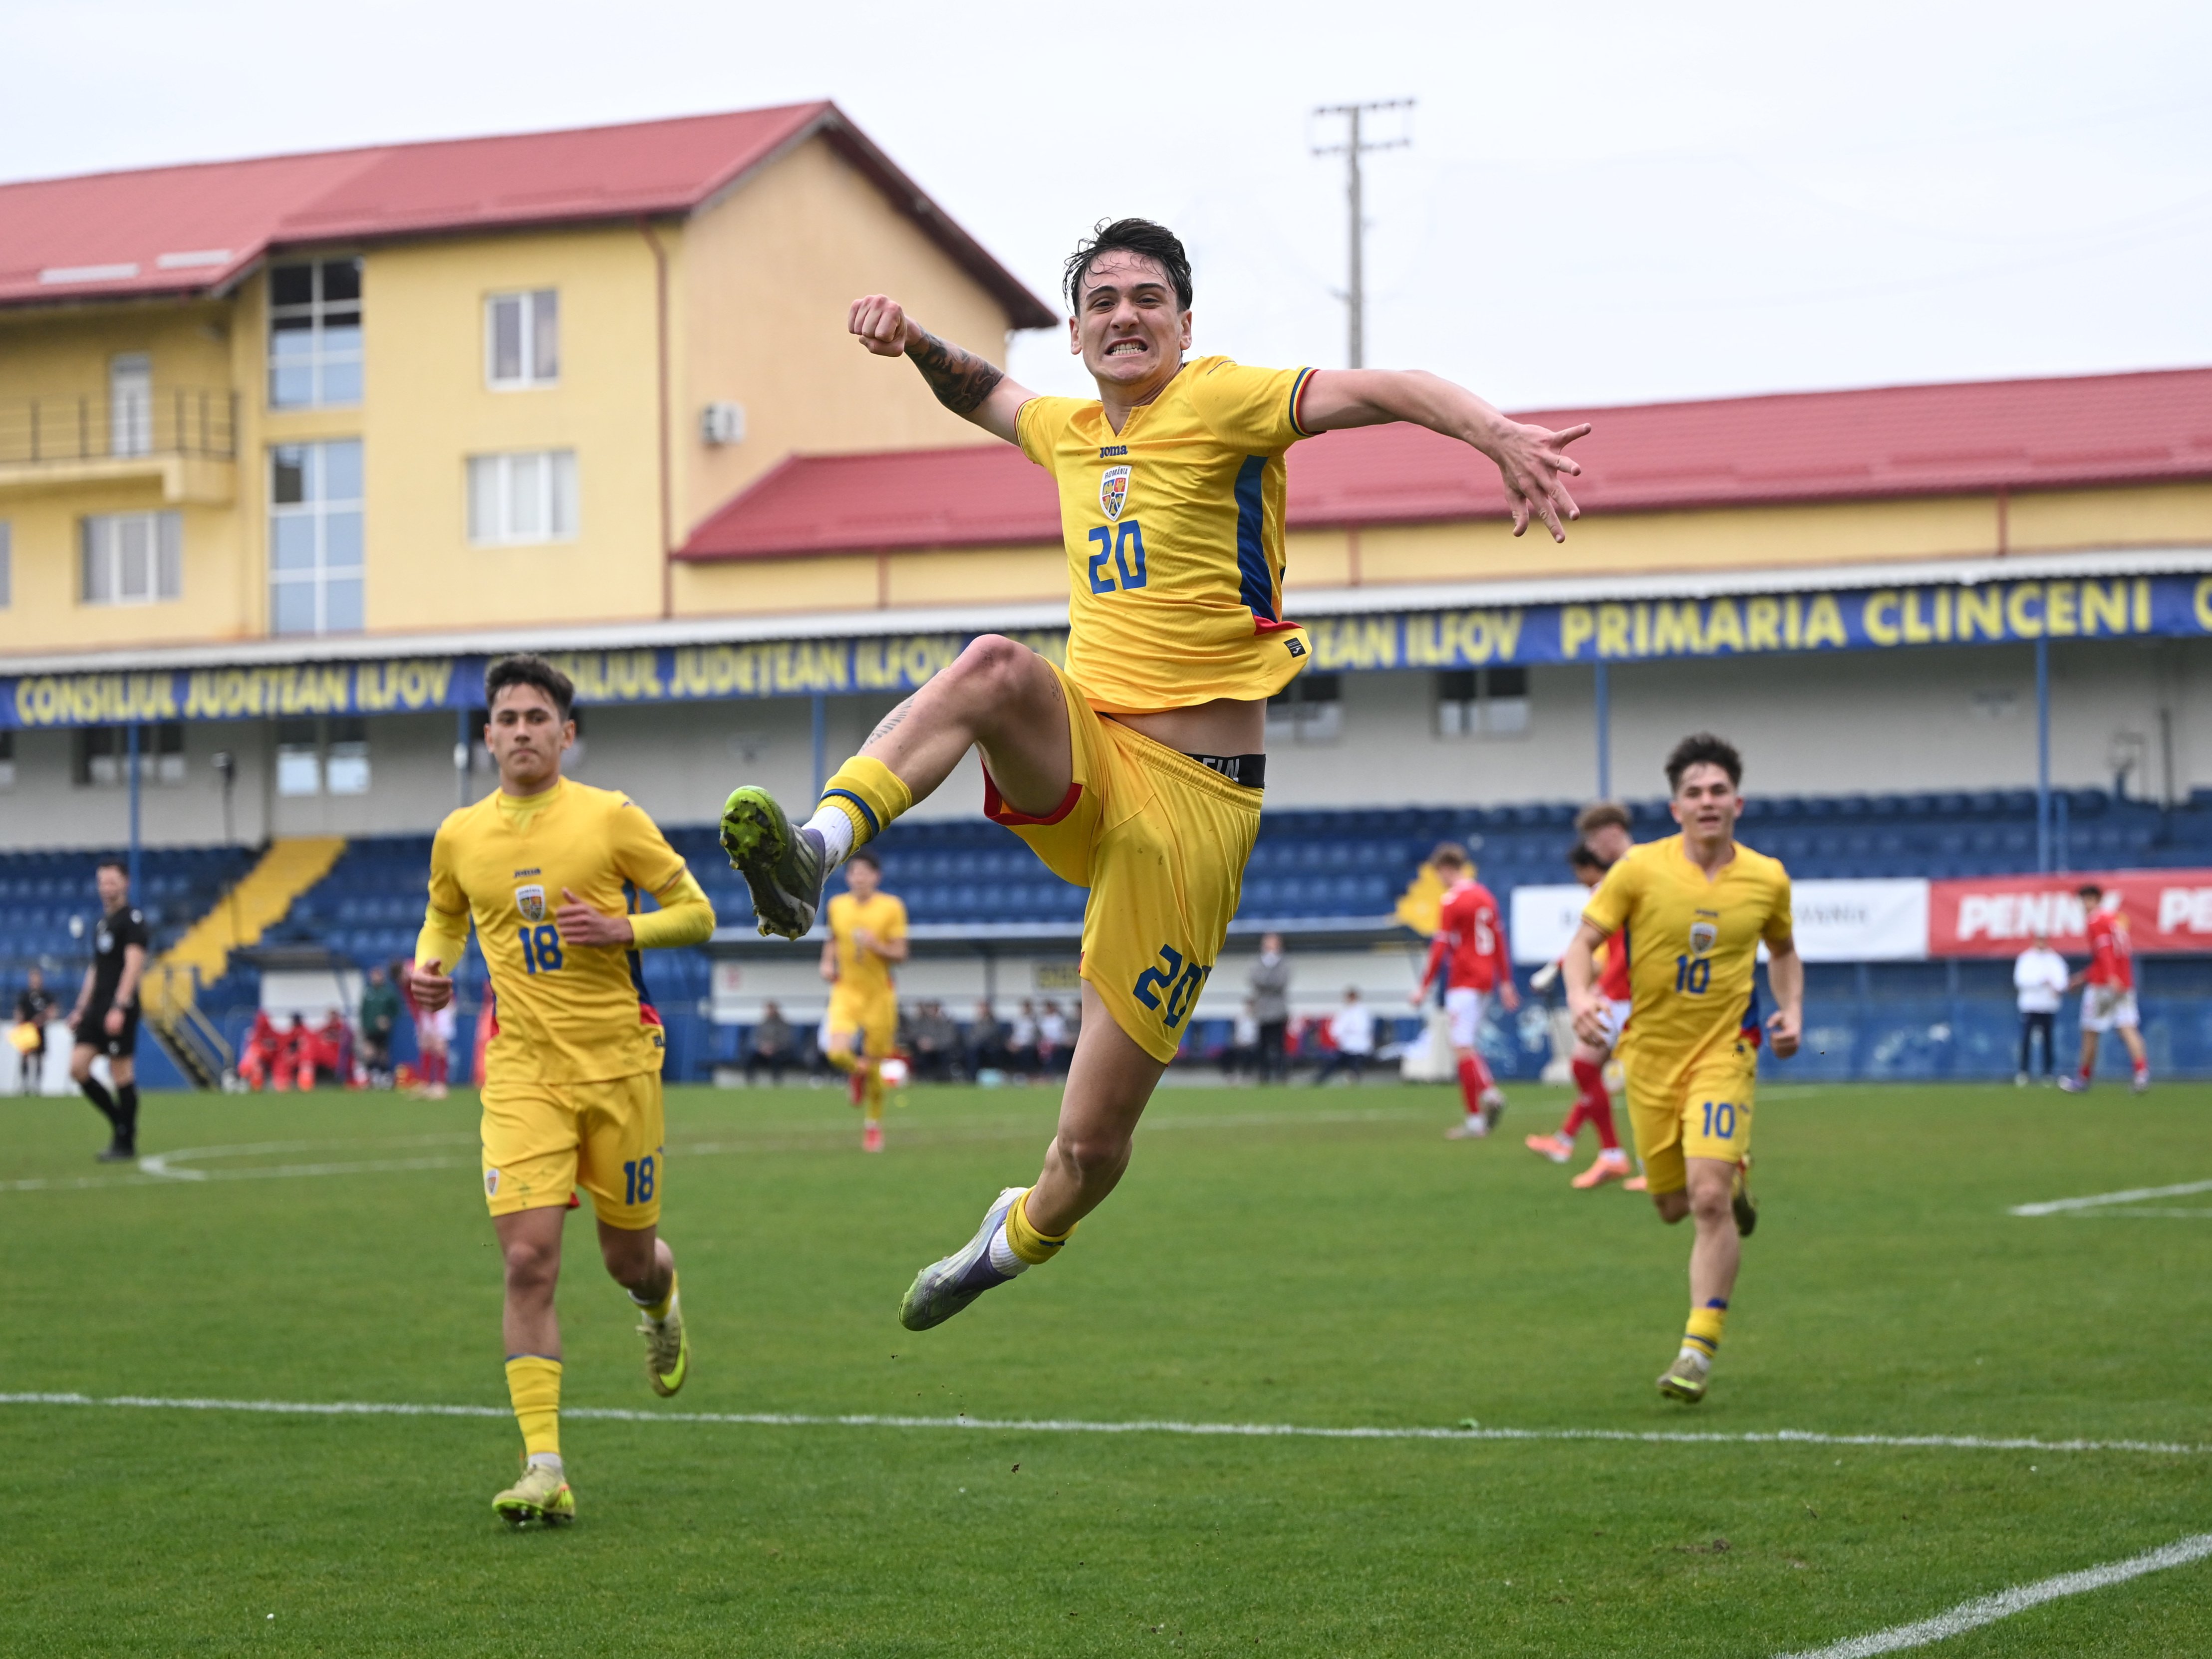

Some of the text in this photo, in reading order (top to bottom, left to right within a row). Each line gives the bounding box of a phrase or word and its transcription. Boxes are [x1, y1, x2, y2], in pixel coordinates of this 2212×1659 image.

[1105, 467, 1128, 480] ROMÂNIA
[1089, 520, 1146, 594] 20
[1404, 606, 1524, 668] ILFOV
[1560, 591, 1846, 659] PRIMARIA
[1863, 575, 2152, 646] CLINCENI
[15, 671, 177, 726] CONSILIUL
[355, 659, 454, 711] ILFOV
[519, 925, 562, 974] 18
[1676, 955, 1710, 993] 10
[1132, 944, 1203, 1028] 20
[1703, 1102, 1735, 1139] 10
[623, 1156, 654, 1205] 18
